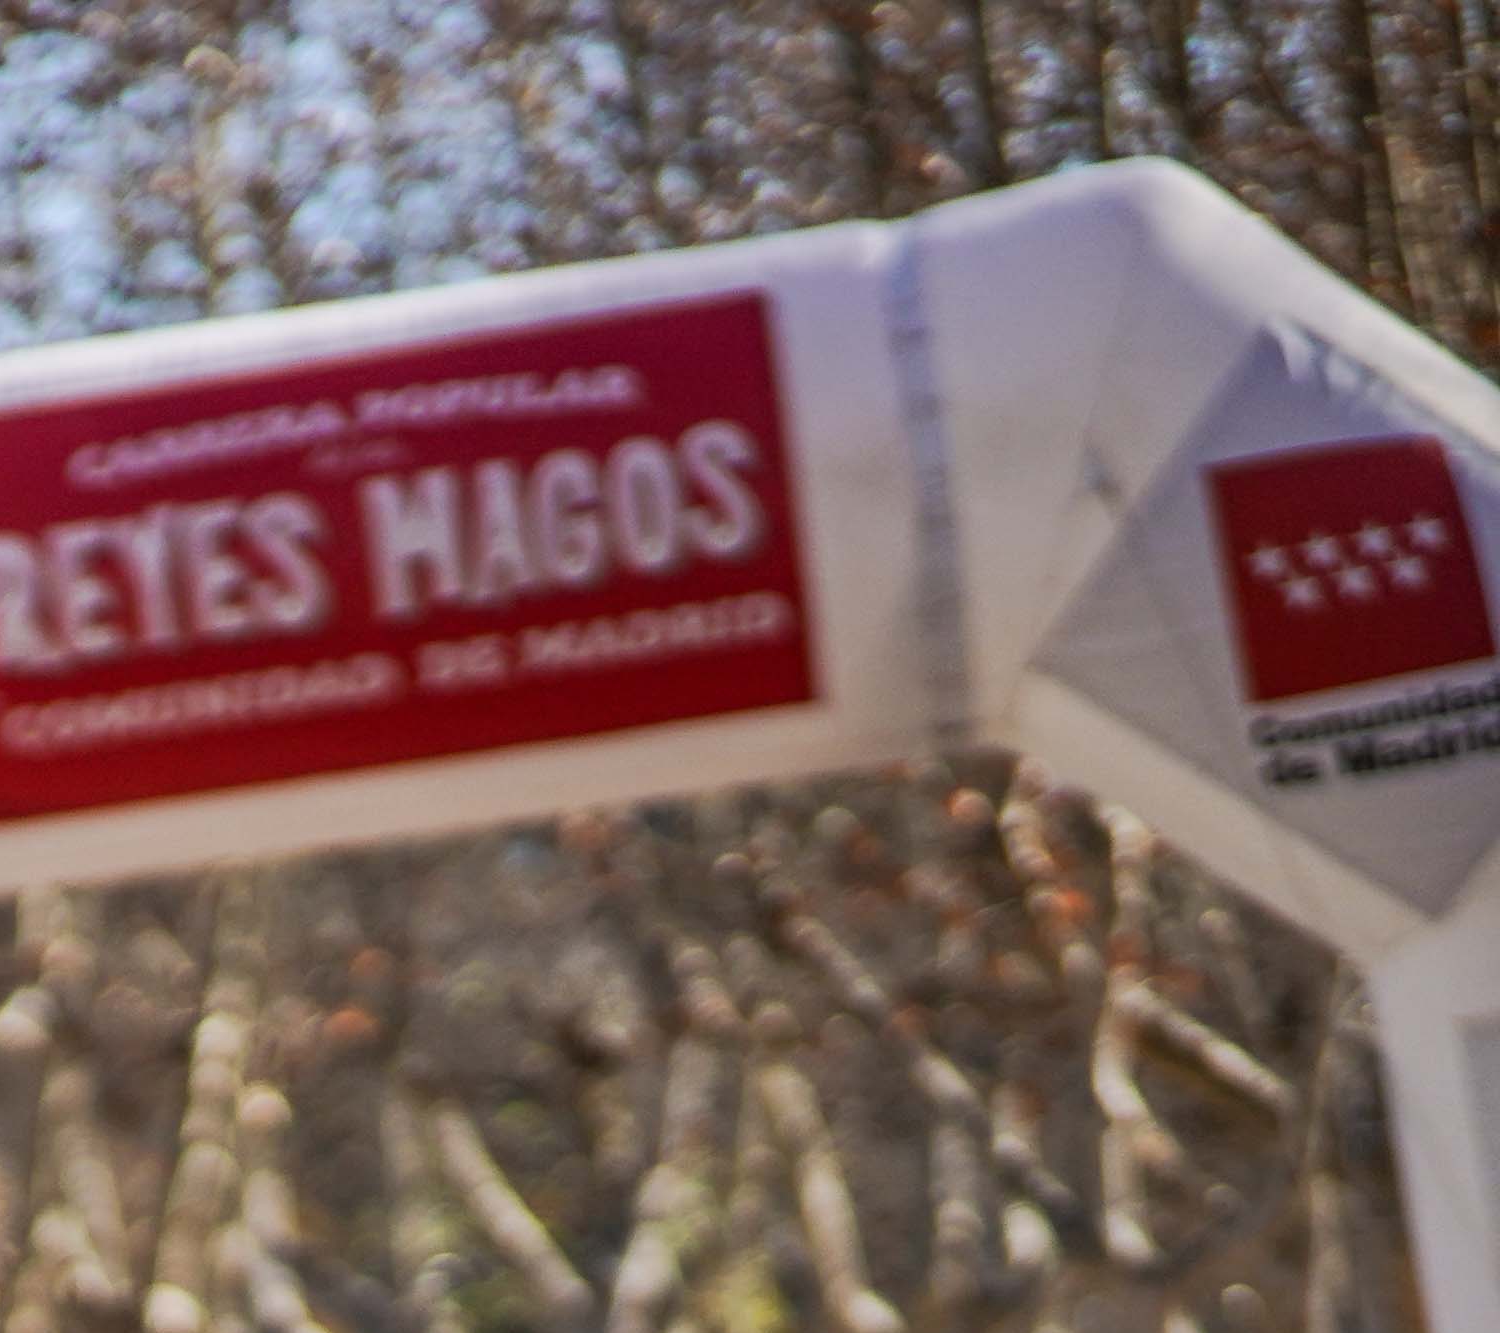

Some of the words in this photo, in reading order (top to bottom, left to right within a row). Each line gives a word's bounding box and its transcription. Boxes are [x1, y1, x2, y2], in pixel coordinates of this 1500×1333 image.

[353, 365, 648, 430] POPULAR
[358, 420, 764, 622] MAGOS
[412, 632, 508, 690] DE
[517, 592, 796, 675] MADRID
